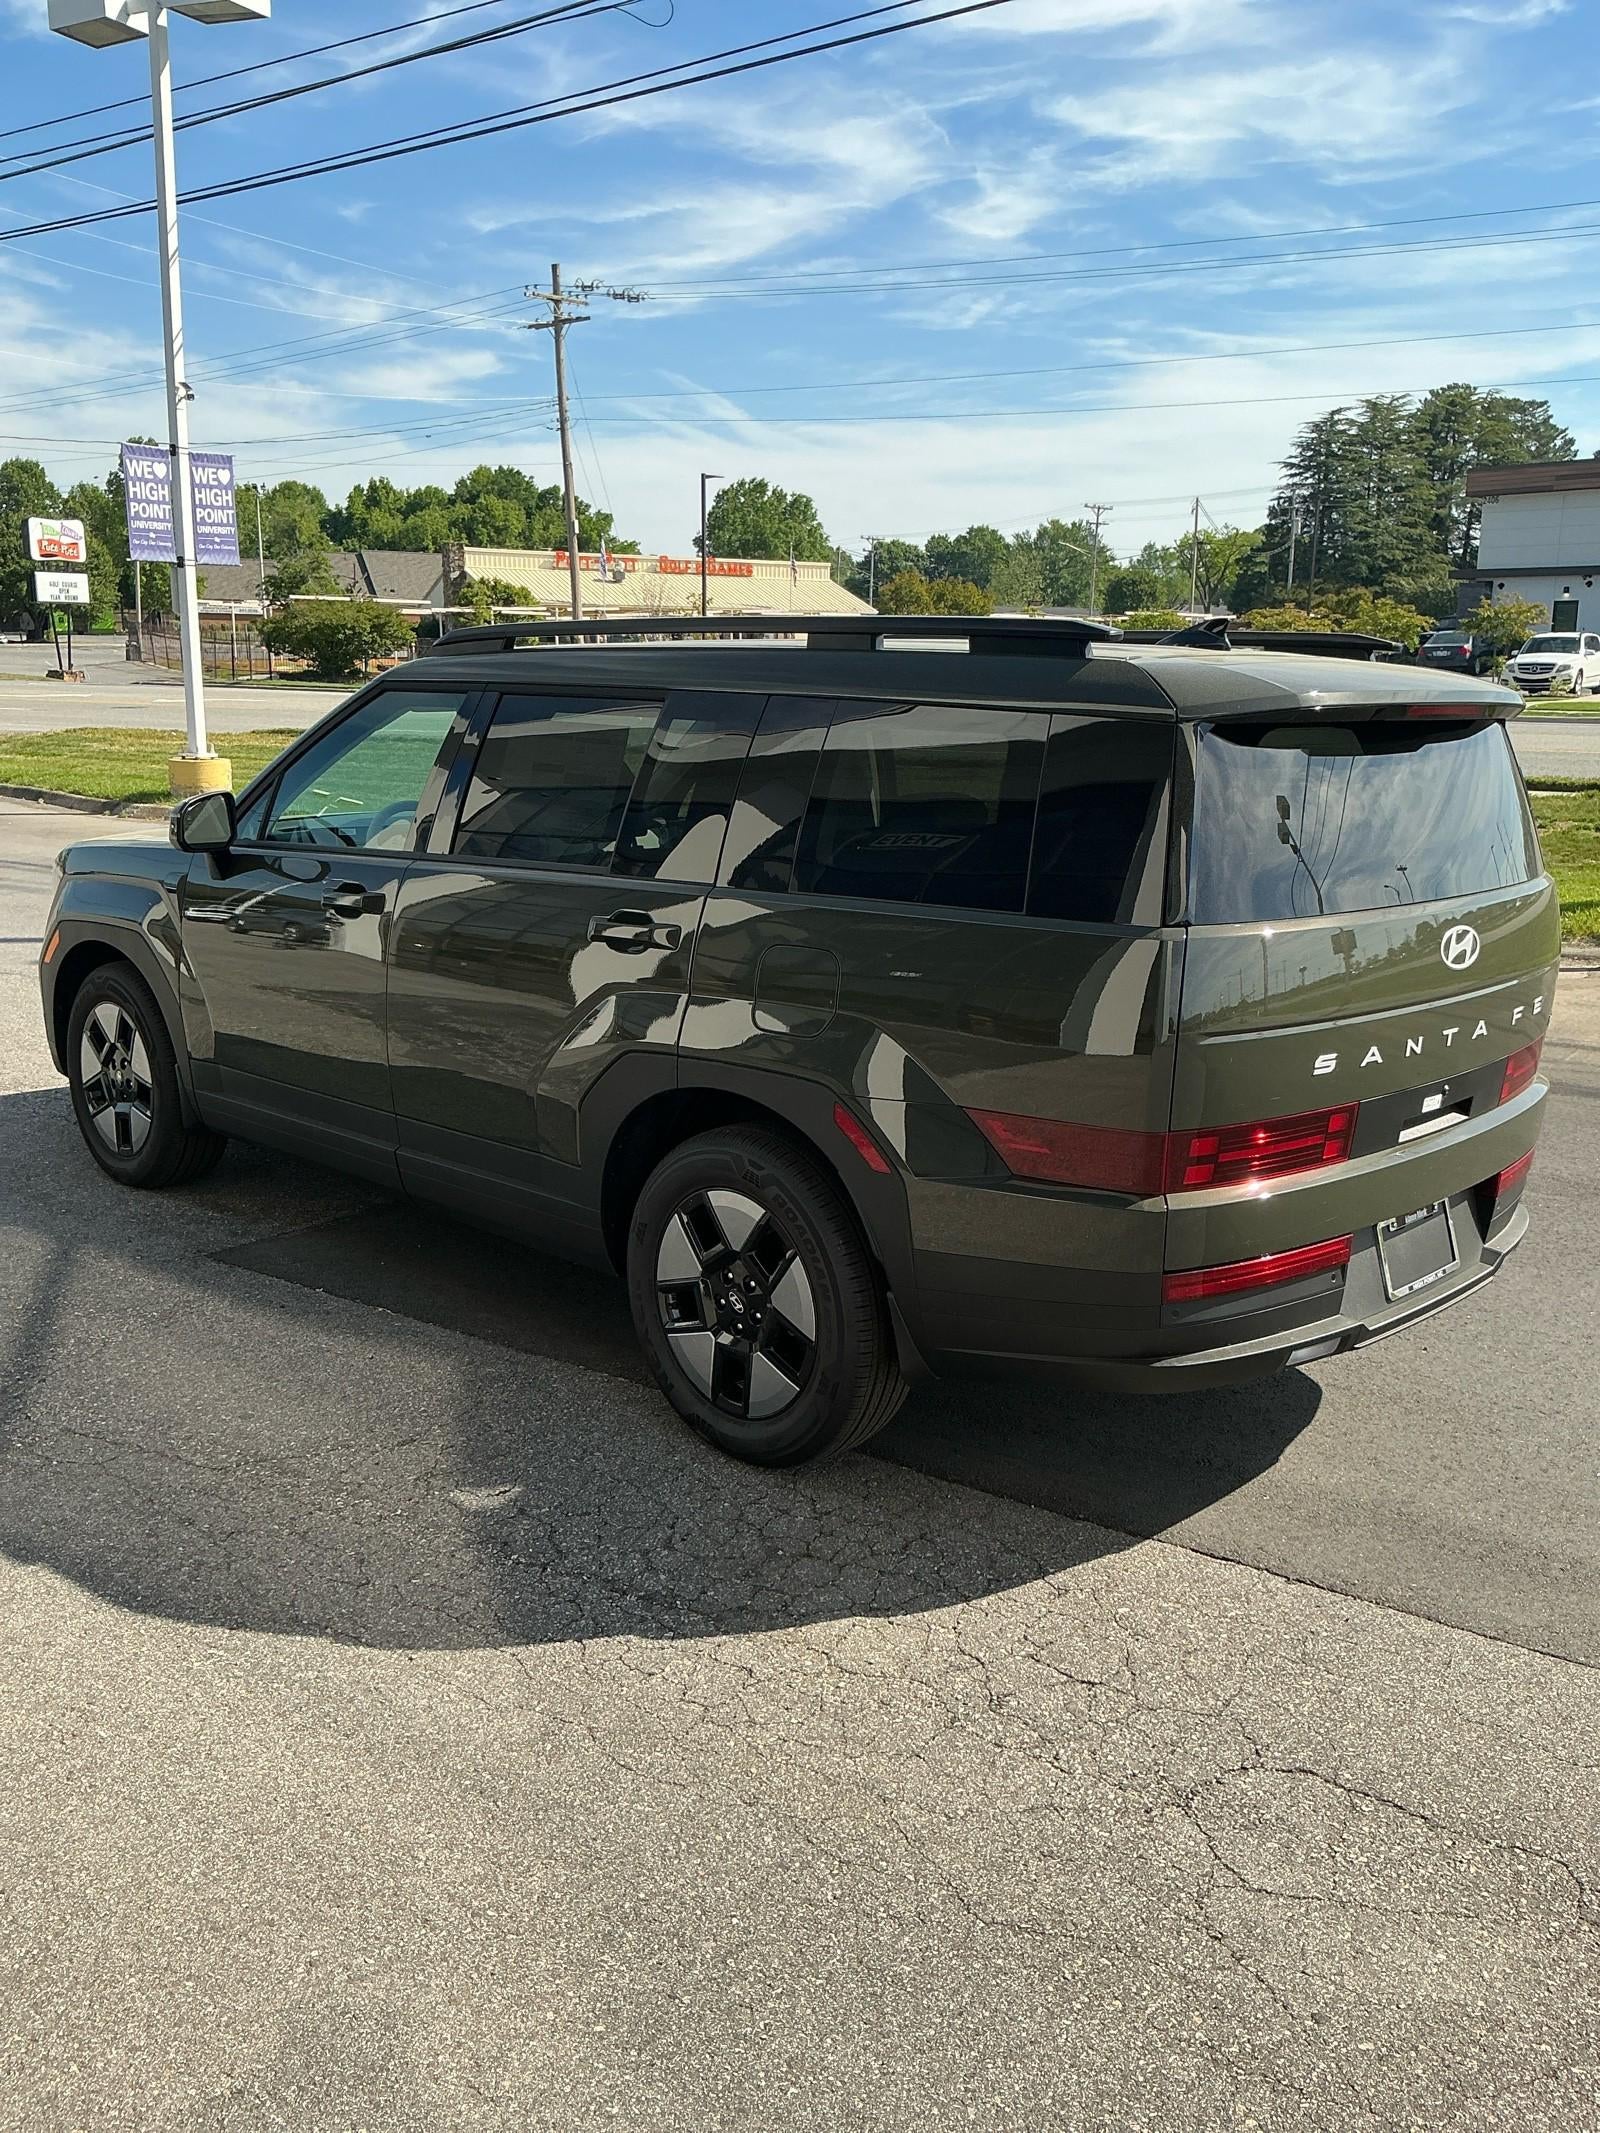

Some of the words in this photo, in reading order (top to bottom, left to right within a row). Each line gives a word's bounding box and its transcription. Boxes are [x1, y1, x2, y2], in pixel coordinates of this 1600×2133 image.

[126, 458, 153, 479] WE
[192, 466, 218, 485] WE
[128, 481, 169, 502] HIGH
[194, 488, 233, 507] HIGH
[130, 501, 171, 520] POINT
[196, 508, 234, 524] POINT
[131, 519, 172, 531] UNIVERSITY
[197, 525, 235, 535] UNIVERSITY
[707, 556, 753, 576] GAMES
[1312, 1019, 1489, 1076] SANTA
[1511, 995, 1544, 1026] FE
